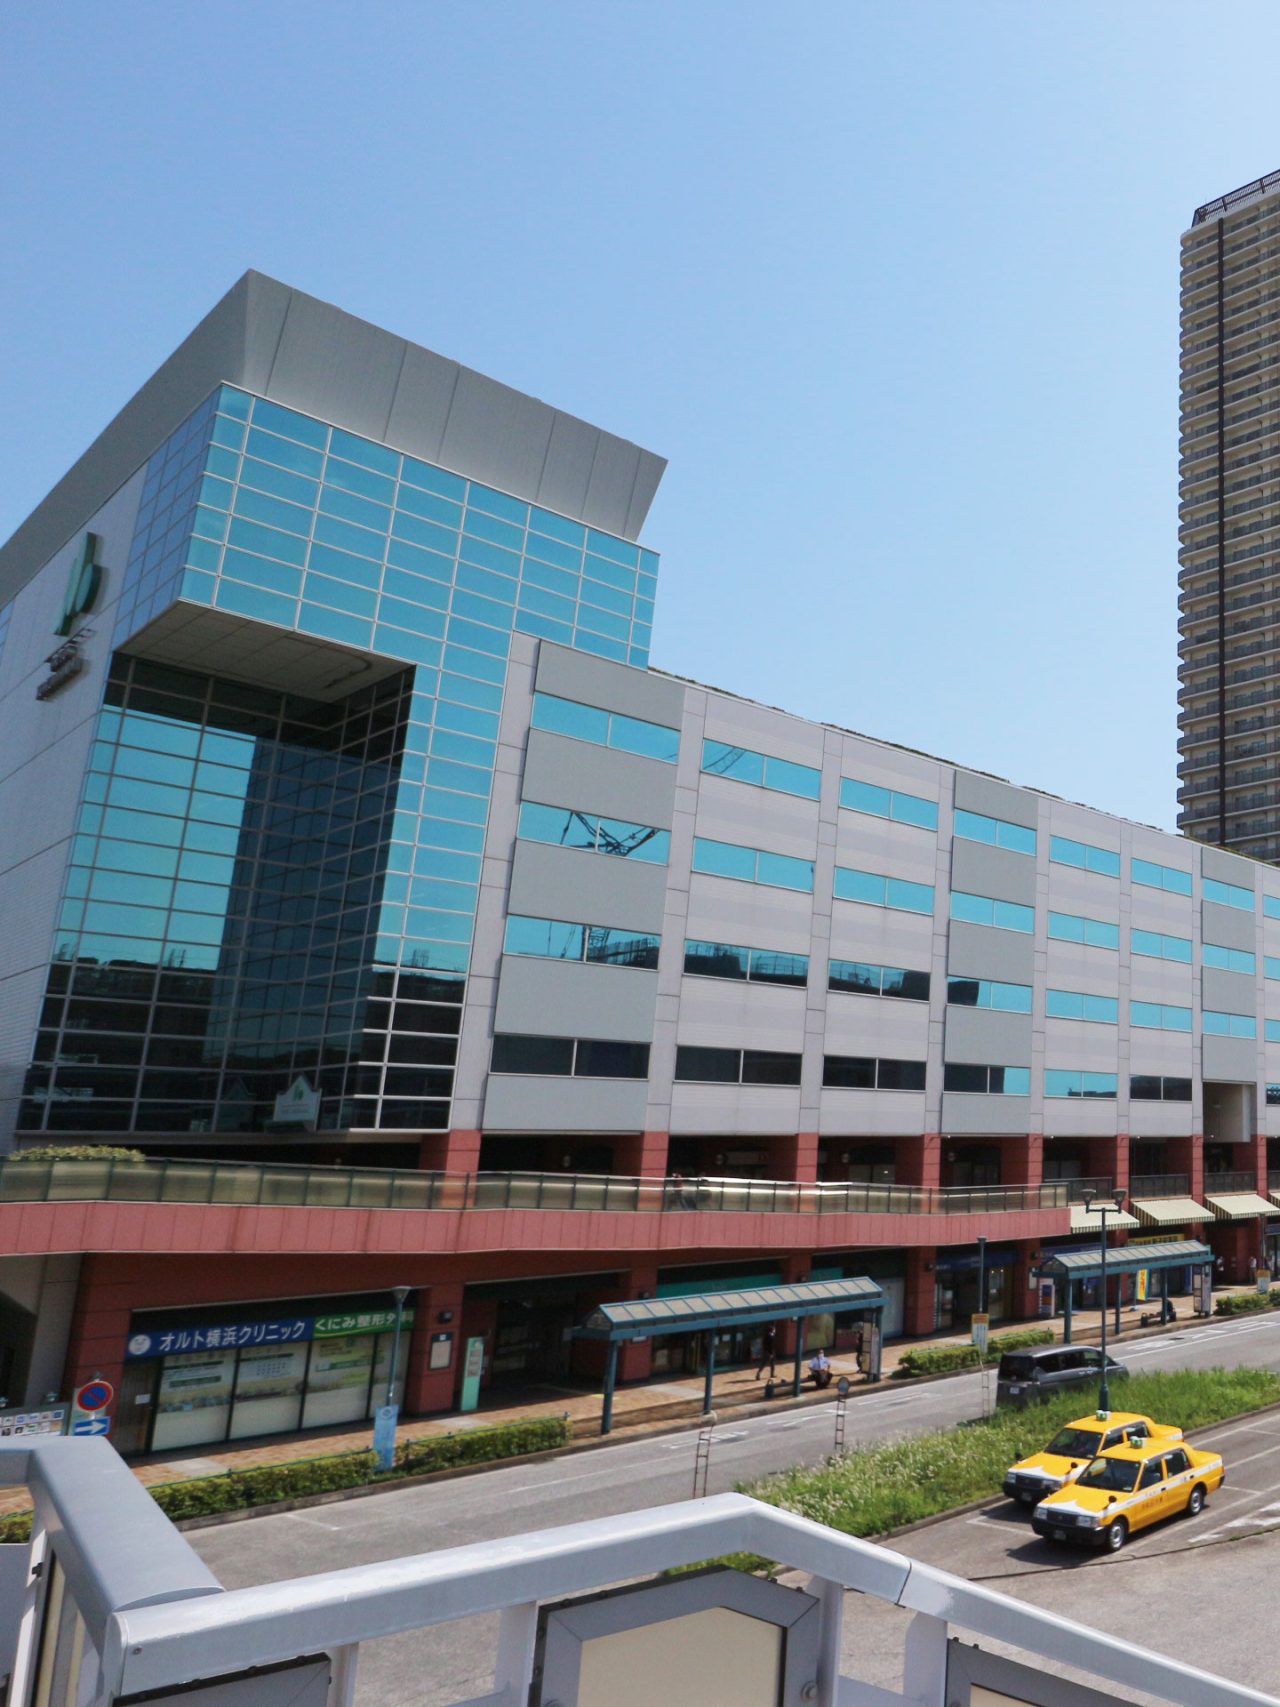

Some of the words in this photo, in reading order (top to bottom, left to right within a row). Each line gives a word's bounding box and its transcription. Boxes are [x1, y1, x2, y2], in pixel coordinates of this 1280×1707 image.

[160, 1321, 305, 1350] オルト横浜クリニック
